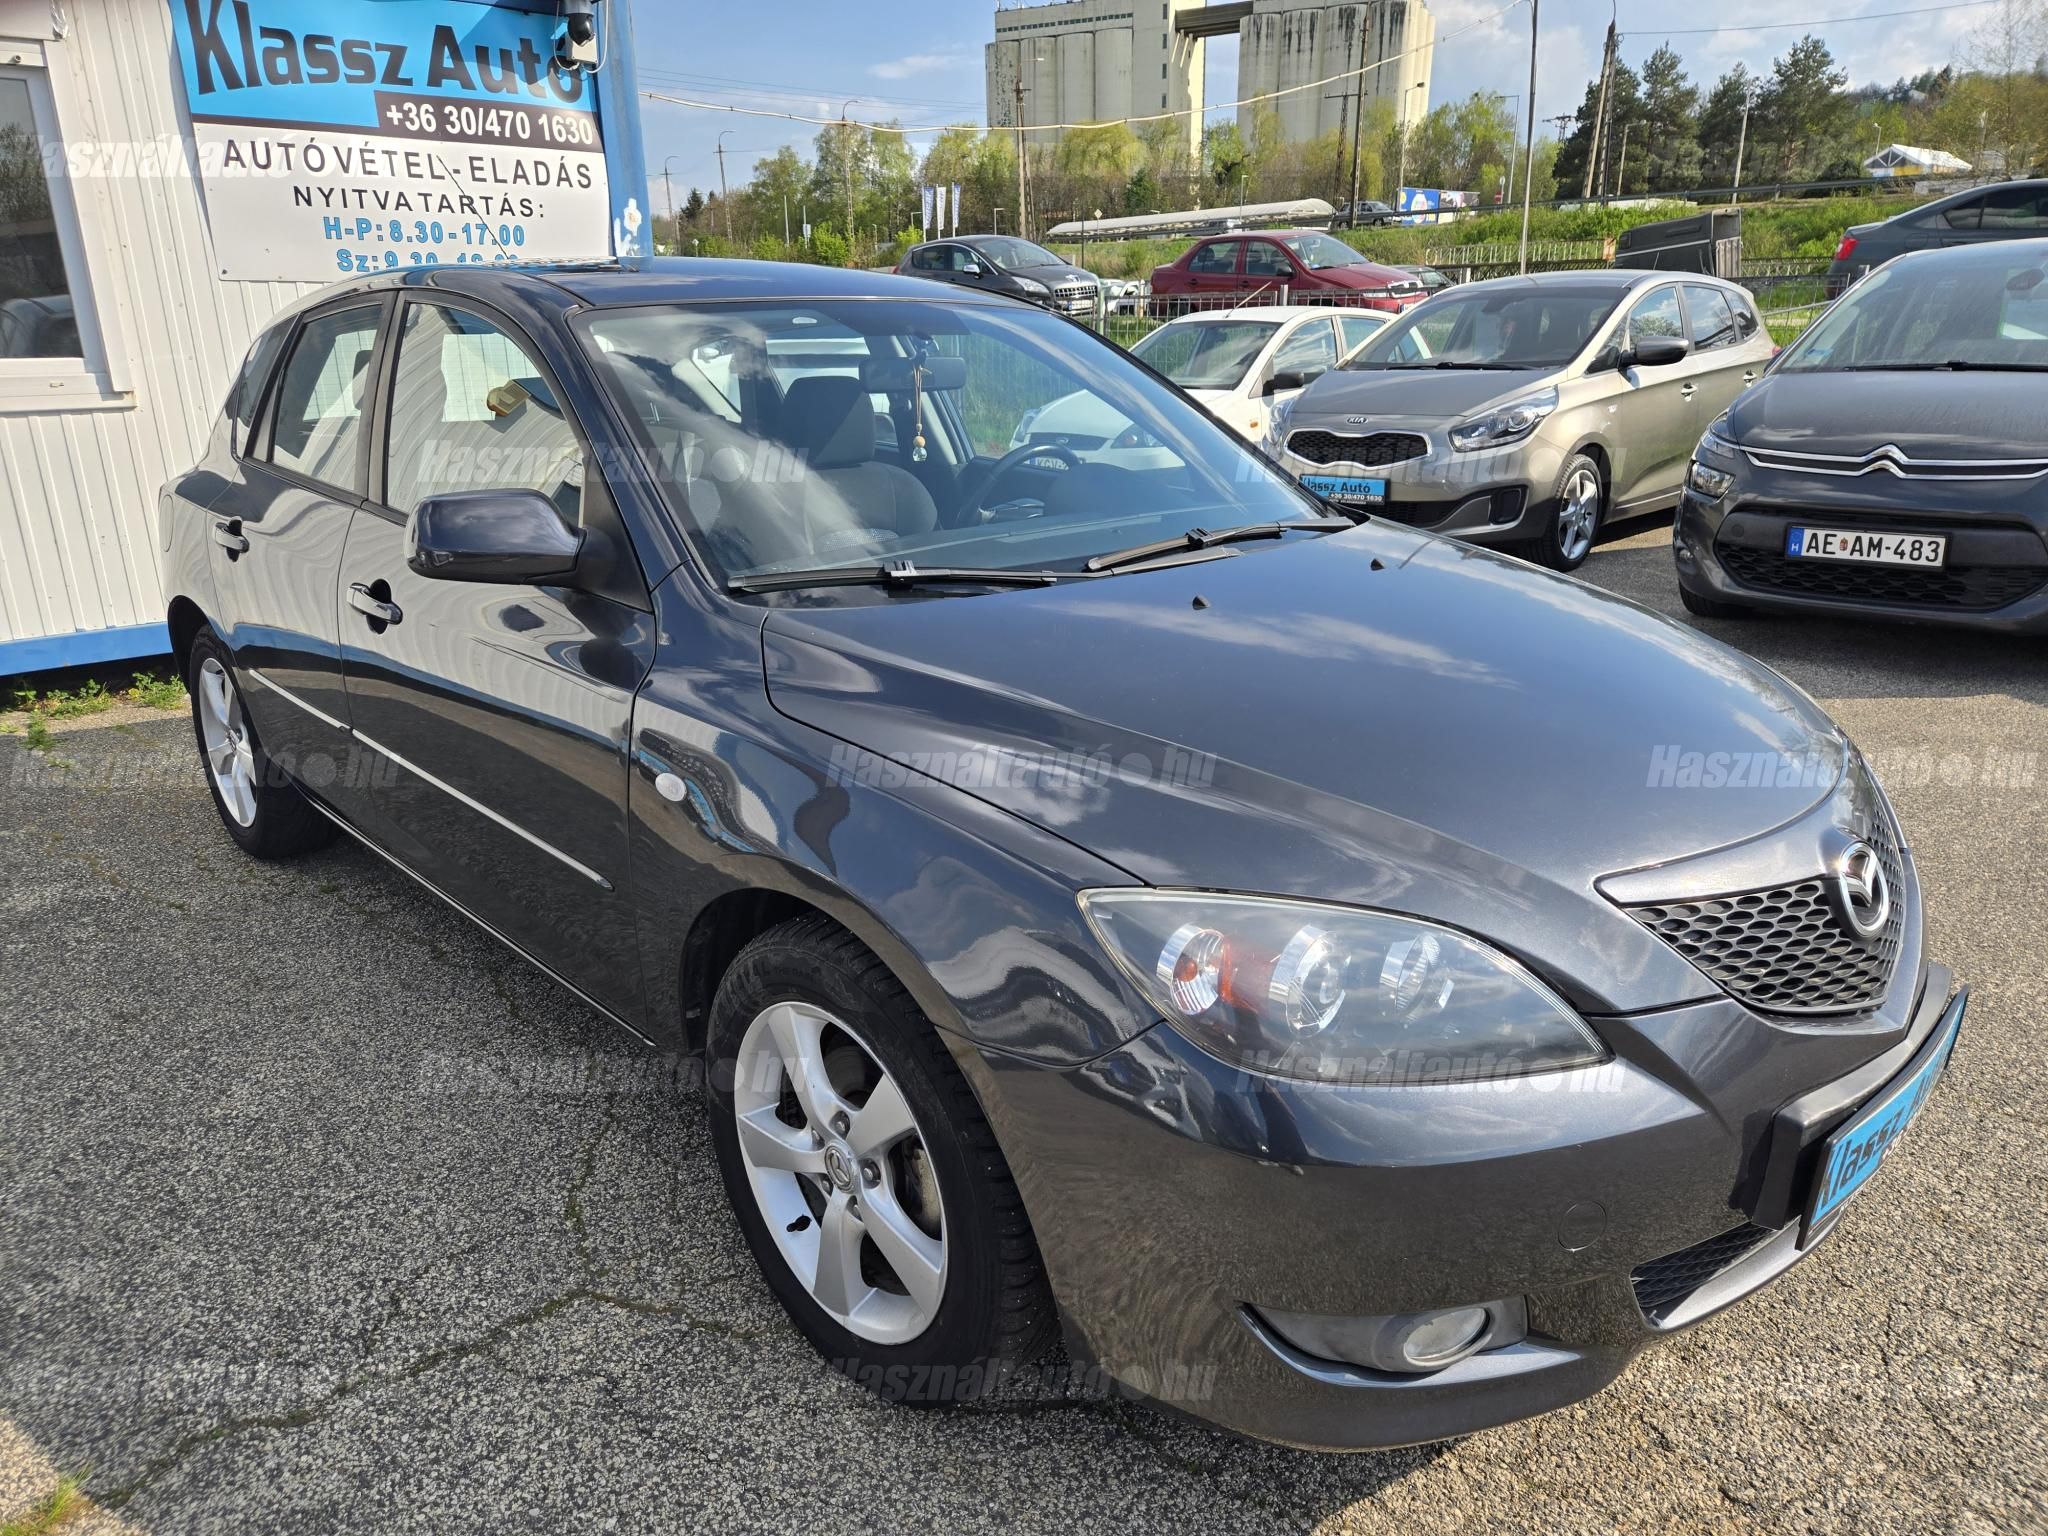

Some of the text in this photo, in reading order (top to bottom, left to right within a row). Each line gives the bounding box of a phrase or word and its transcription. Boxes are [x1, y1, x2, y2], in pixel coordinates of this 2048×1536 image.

[184, 0, 583, 104] Klassz Autó
[386, 102, 594, 145] +36 30/470 1630
[293, 185, 545, 218] NYITVATARTÁS:
[1340, 482, 1371, 494] Autó
[1791, 533, 1941, 563] H AE AM-483
